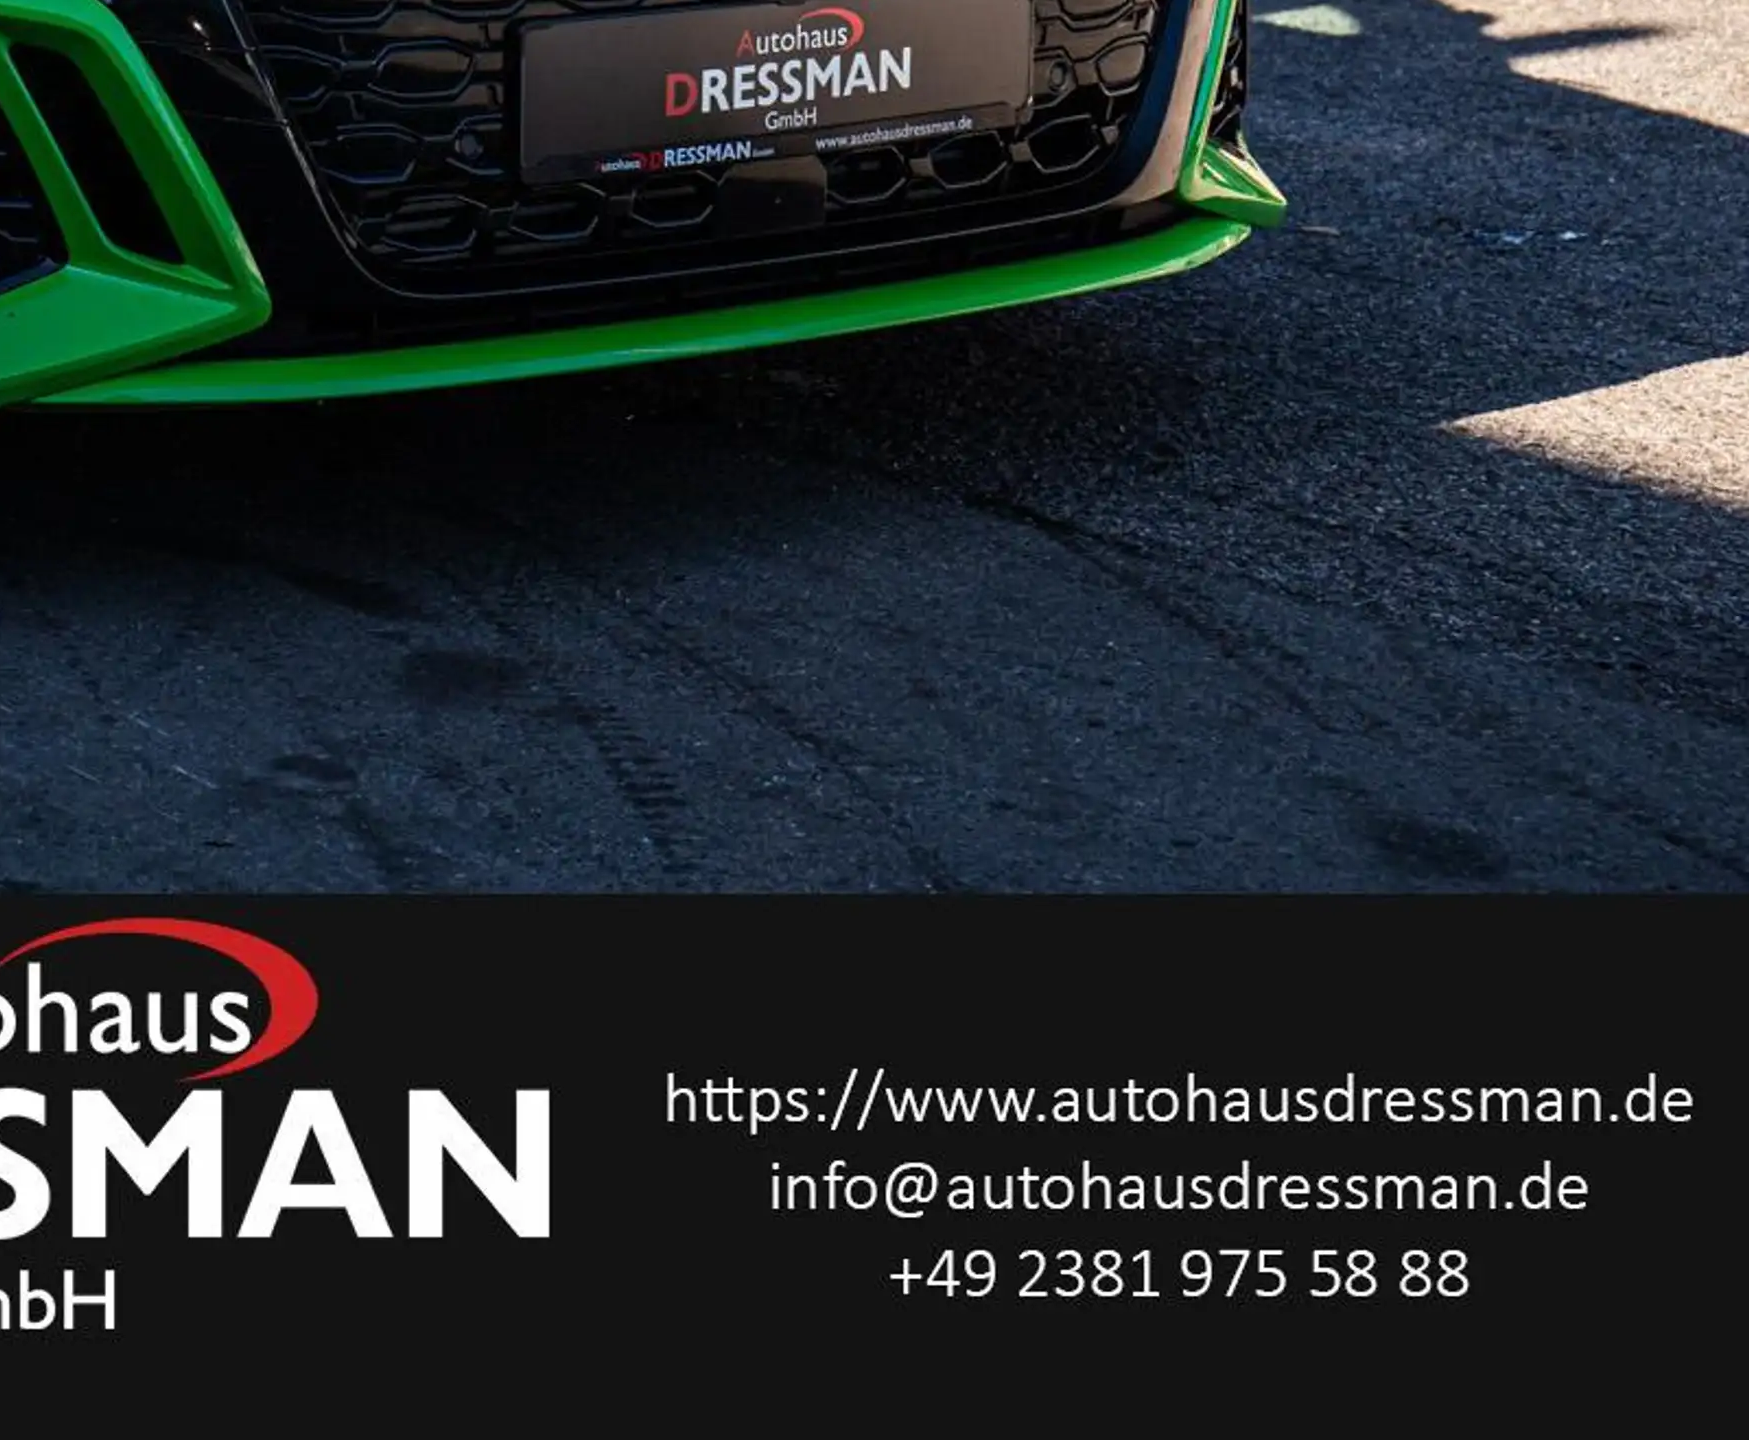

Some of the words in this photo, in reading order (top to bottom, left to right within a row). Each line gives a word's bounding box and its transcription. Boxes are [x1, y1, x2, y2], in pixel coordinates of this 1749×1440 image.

[736, 22, 849, 58] Autohaus
[664, 46, 912, 117] DRESSMAN
[764, 106, 818, 131] GmbH
[814, 114, 974, 151] www.autohausdressman.de
[653, 141, 752, 171] DRESSMAN
